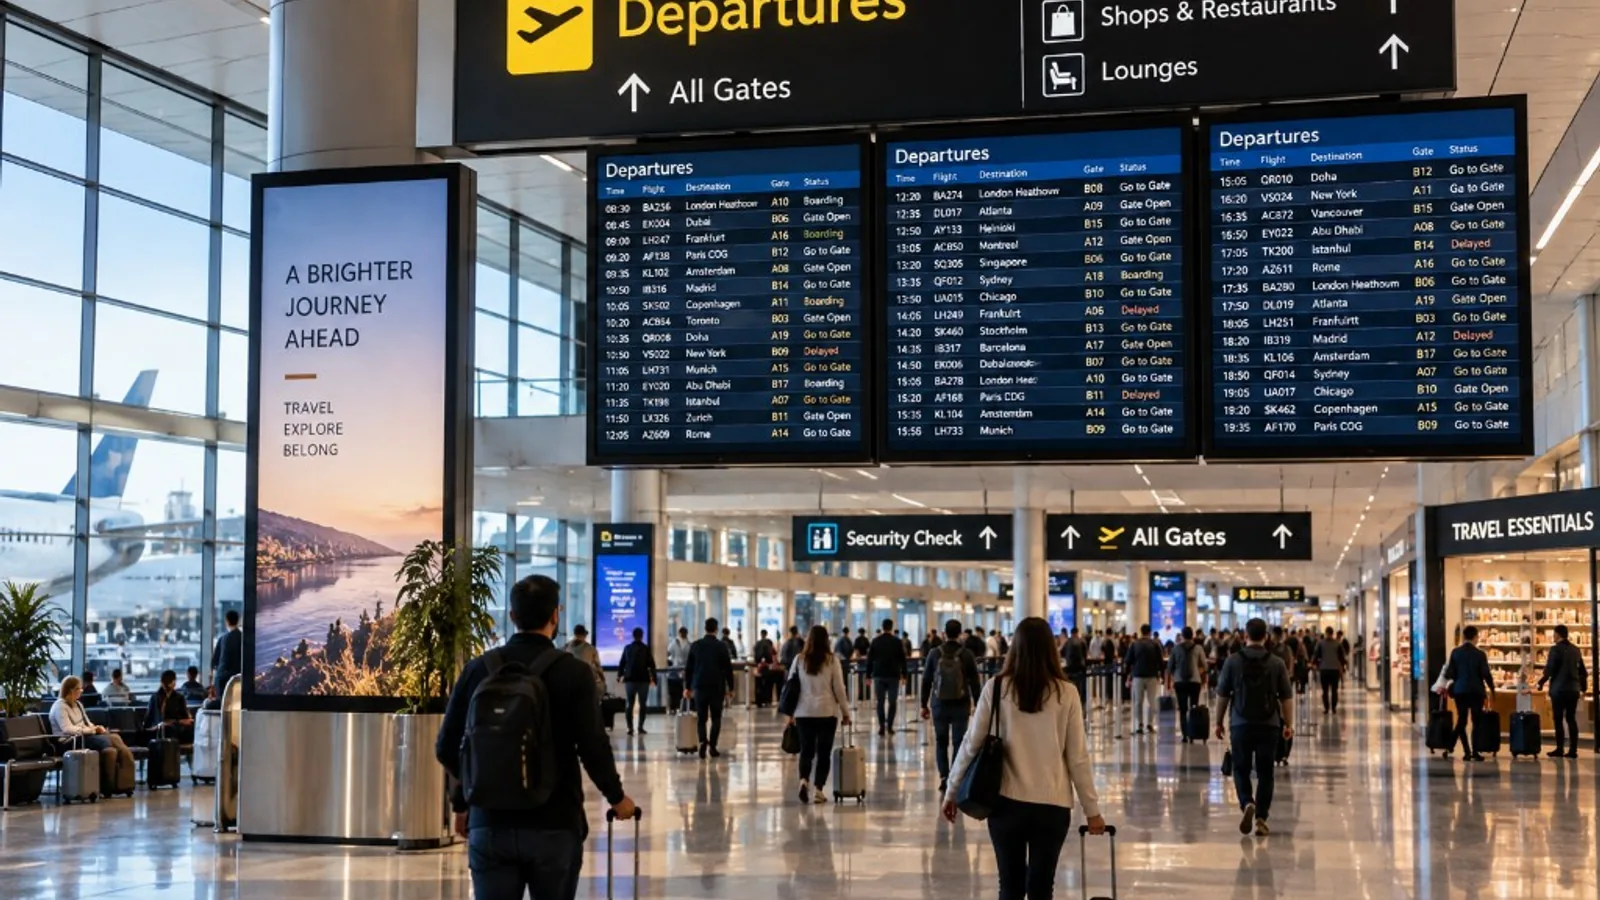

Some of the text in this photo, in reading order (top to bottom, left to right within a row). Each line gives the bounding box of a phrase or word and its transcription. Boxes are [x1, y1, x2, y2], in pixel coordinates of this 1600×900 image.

[1101, 0, 1337, 29] Shops & Restaurants
[618, 0, 906, 46] Departures
[1102, 60, 1198, 83] Lounges
[669, 77, 791, 105] All Gates
[1220, 130, 1320, 150] Departures
[895, 148, 990, 167] Departures
[1261, 155, 1285, 167] Flight
[1311, 152, 1362, 162] Destination
[1413, 146, 1433, 156] Gate
[1450, 145, 1478, 154] Status
[606, 162, 694, 181] Departures
[896, 163, 1146, 183] Time Destination Gate Status
[1220, 162, 1504, 187] 15:05 Doha B12 Go to Gate
[686, 183, 730, 192] Destination
[771, 179, 789, 188] Gate
[979, 188, 1013, 199] London
[1120, 182, 1134, 192] Go
[1136, 182, 1146, 191] to
[1149, 180, 1171, 191] Gate
[1261, 184, 1431, 203] VS024 New York A11
[686, 196, 789, 211] London A10
[979, 206, 1012, 216] Atlanta
[1084, 201, 1103, 211] A09
[1311, 201, 1504, 219] Vancouver B15 Gate Open
[803, 211, 851, 223] Gate Open
[771, 230, 788, 241] A16
[1084, 234, 1171, 247] A12 Gate Open
[1262, 227, 1293, 239] EY022
[772, 245, 851, 257] B12 Go to Gate
[1221, 238, 1490, 258] 17:05 TK200 B14 Delayed
[980, 257, 1027, 270] Singapore
[1222, 258, 1434, 276] 17:20 Rome A16
[285, 260, 413, 285] A BRIGHTER
[980, 274, 1013, 287] Sydney
[1121, 270, 1163, 282] Boarding
[1313, 280, 1348, 291] London
[772, 297, 788, 307] A11
[980, 288, 1104, 304] Chicago B10
[1312, 294, 1435, 309] Atlanta A19
[285, 293, 387, 317] JOURNEY
[1121, 304, 1159, 317] Delayed
[772, 313, 788, 324] B03
[1416, 313, 1435, 324] B03
[686, 330, 789, 342] Doha A19
[1086, 323, 1104, 334] B13
[284, 327, 360, 349] AHEAD
[1086, 340, 1104, 350] A17
[1223, 330, 1435, 347] 18:20 IB319 Madrid A12
[686, 348, 705, 358] New
[707, 348, 726, 358] York
[1264, 348, 1435, 363] KL106 Amsterdam B17
[1086, 356, 1104, 367] B07
[1086, 373, 1105, 384] A10
[1264, 366, 1436, 381] QF014 Sydney A07
[772, 379, 788, 389] B17
[1224, 382, 1508, 399] 19:05 Chicago B10 Gate Open
[1086, 390, 1103, 401] B11
[284, 401, 334, 415] TRAVEL
[1086, 406, 1173, 417] A14 Go to Gate
[1314, 403, 1377, 416] Copenhagen
[772, 410, 851, 423] B11 Gate Open
[283, 421, 343, 437] EXPLORE
[772, 428, 788, 438] A14
[803, 427, 816, 438] Go
[818, 428, 827, 438] to
[830, 427, 851, 437] Gate
[1418, 419, 1437, 431] B09
[1455, 419, 1469, 430] Go
[1472, 420, 1482, 430] to
[1485, 419, 1509, 430] Gate
[283, 443, 339, 458] BELONG
[1451, 510, 1594, 541] TRAVEL ESSENTIALS
[846, 529, 963, 550] Security Check
[1131, 526, 1227, 547] All Gates
